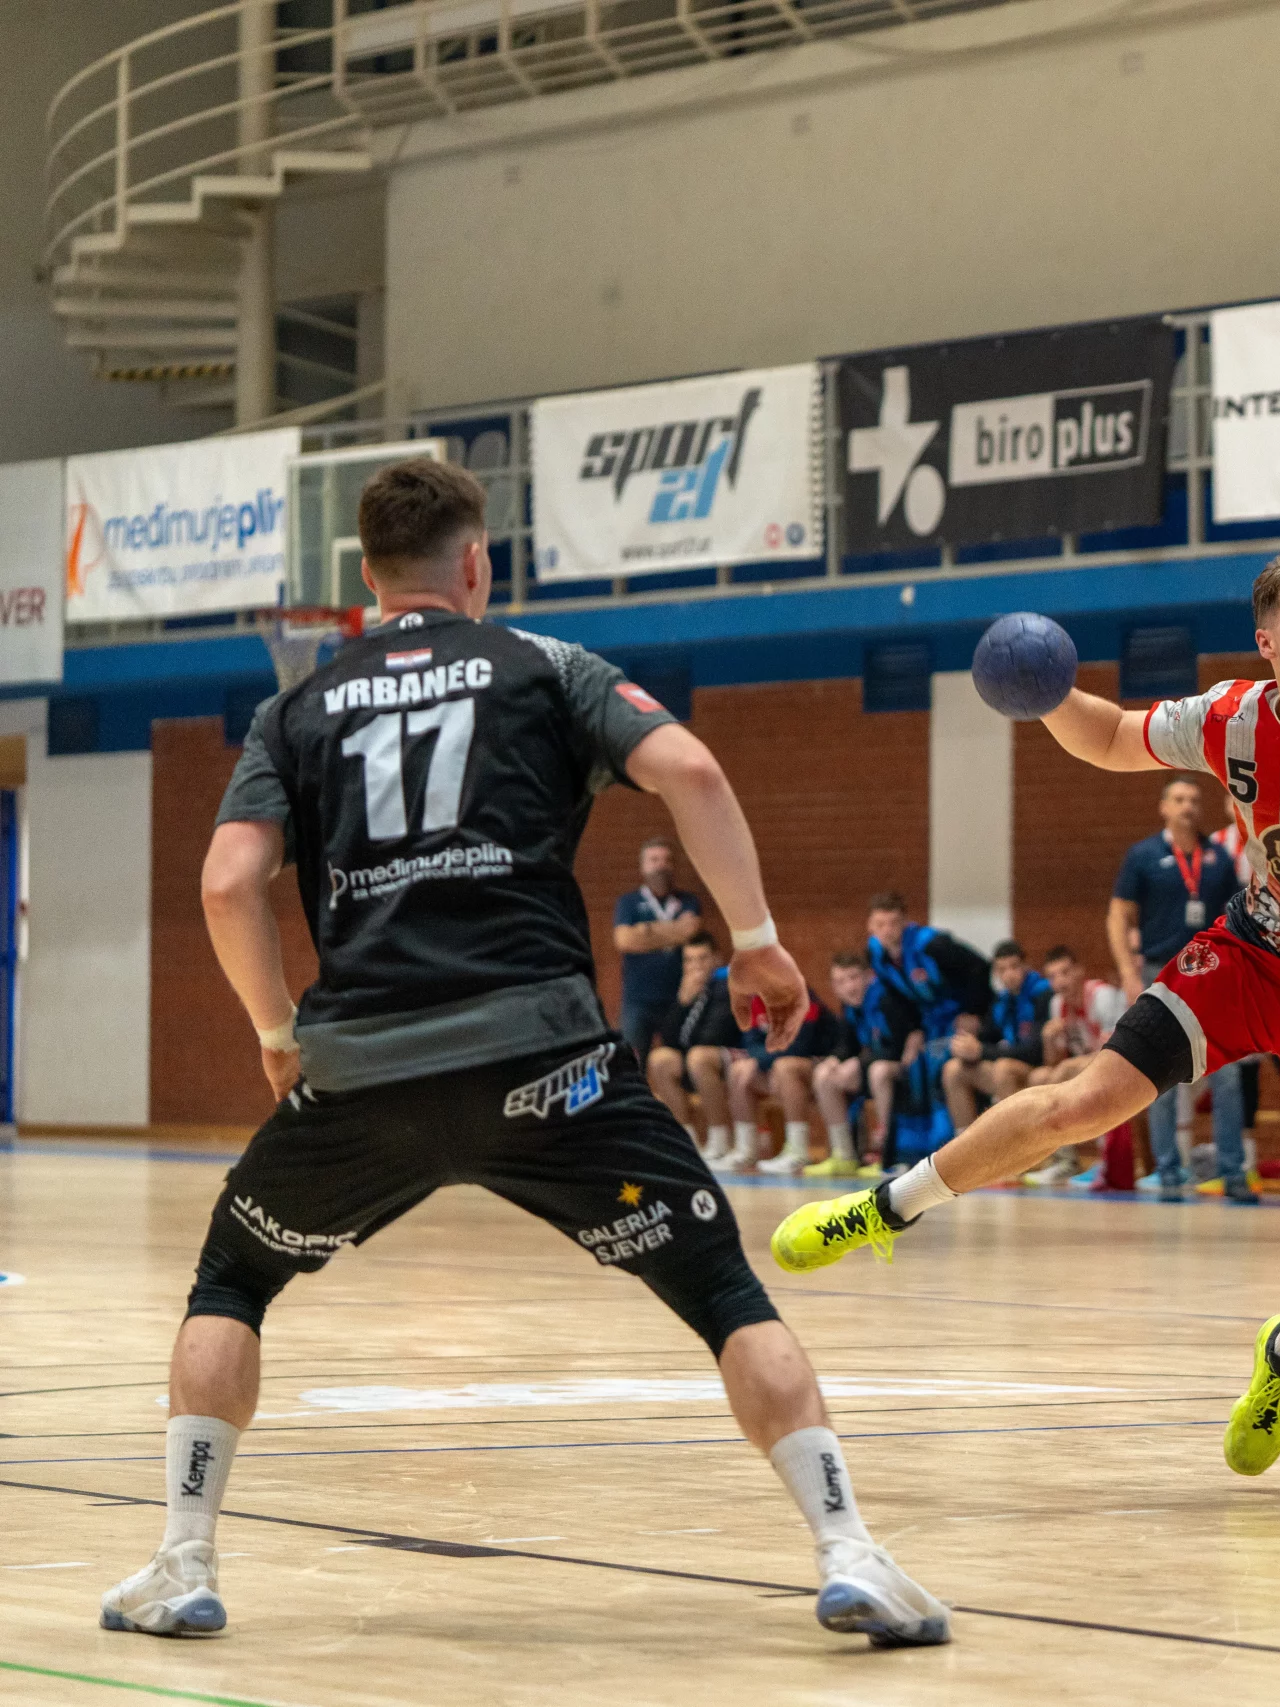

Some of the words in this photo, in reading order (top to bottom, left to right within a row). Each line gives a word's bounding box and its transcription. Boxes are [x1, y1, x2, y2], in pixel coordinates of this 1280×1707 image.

[976, 415, 1044, 466] biro
[1057, 401, 1134, 467] plus
[324, 658, 493, 715] VRBANEC
[341, 697, 475, 841] 17
[1227, 756, 1258, 803] 5
[351, 843, 513, 887] međimurjeplin
[577, 1200, 673, 1248] GALERIJA
[595, 1223, 673, 1264] SJEVER
[181, 1441, 214, 1497] Kempa
